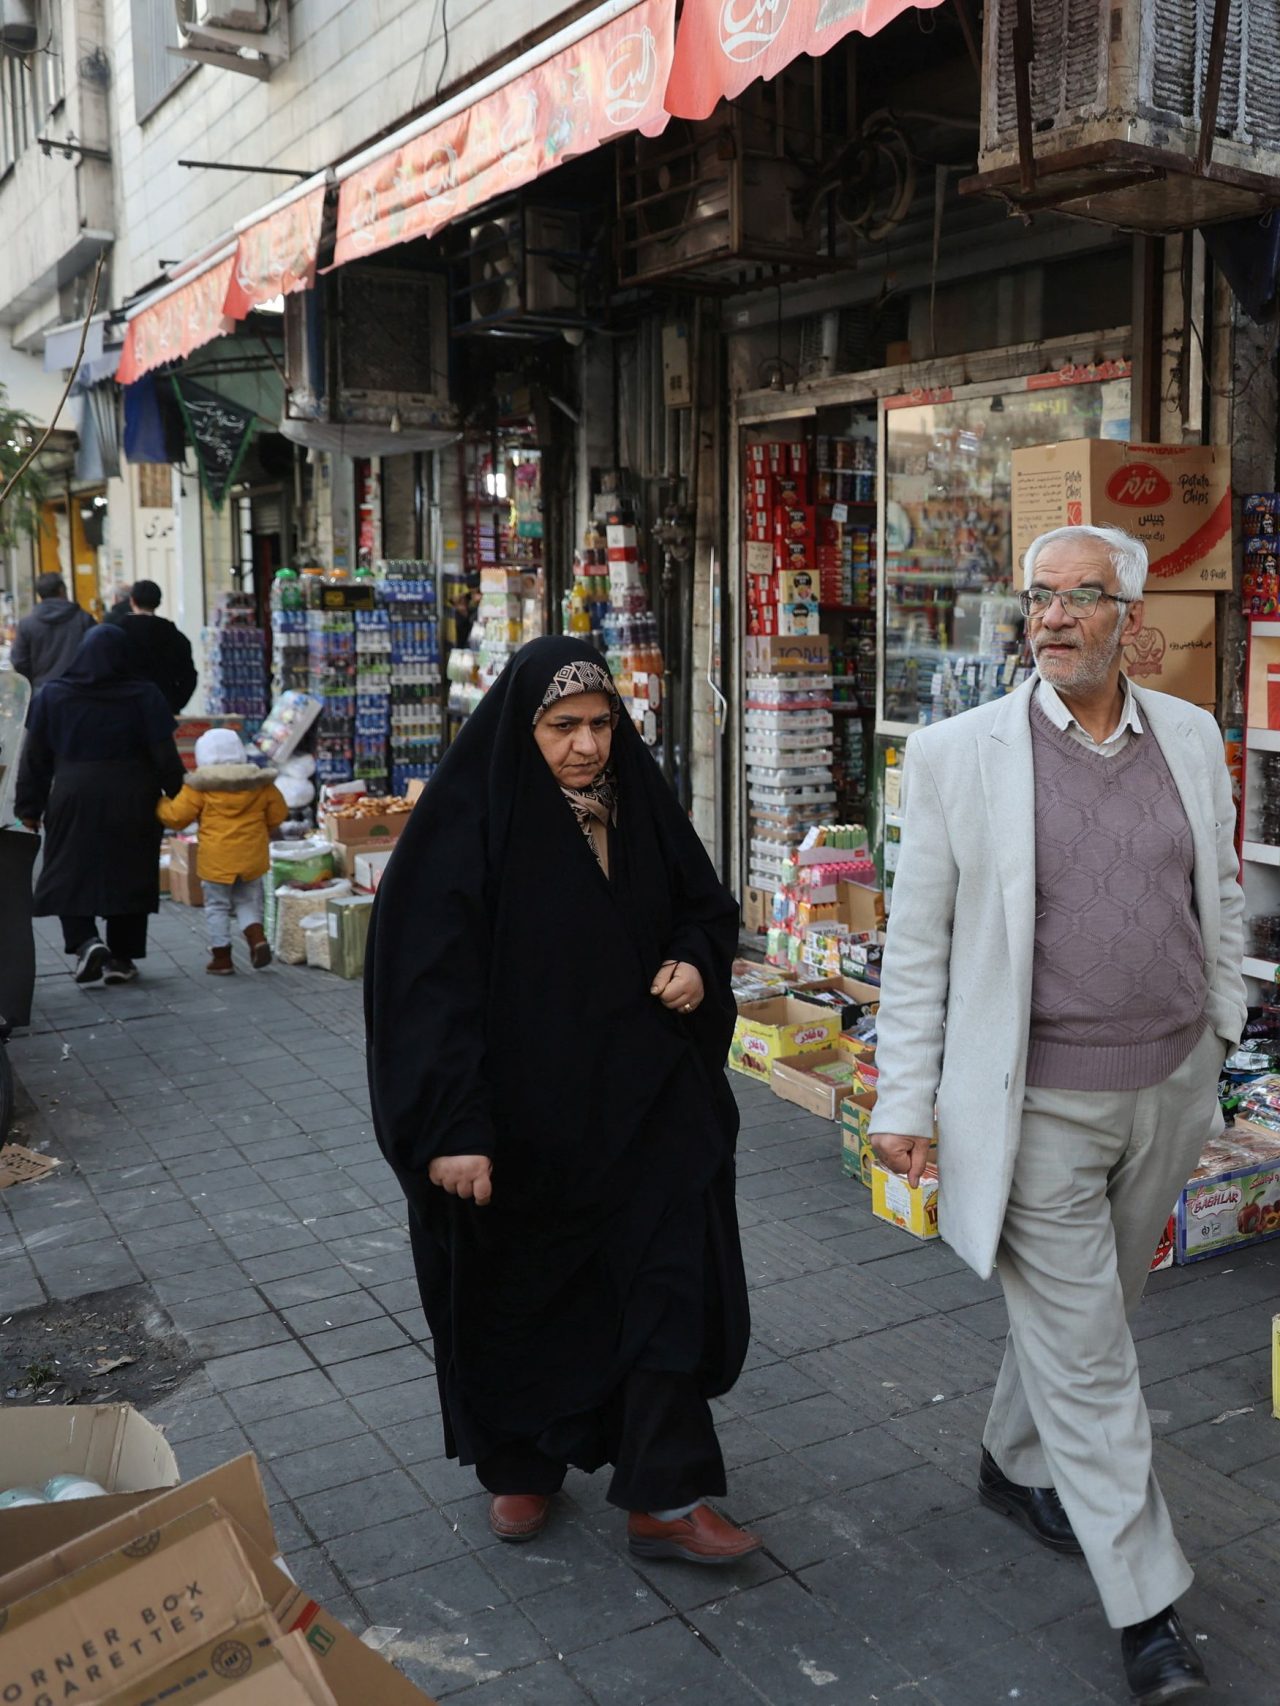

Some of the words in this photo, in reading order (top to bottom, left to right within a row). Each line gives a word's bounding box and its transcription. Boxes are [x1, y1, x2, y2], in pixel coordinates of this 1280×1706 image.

[1178, 473, 1210, 490] Potato
[1183, 489, 1209, 505] Chips
[1194, 1192, 1239, 1213] BAGHLAR
[141, 1581, 205, 1625] BOX
